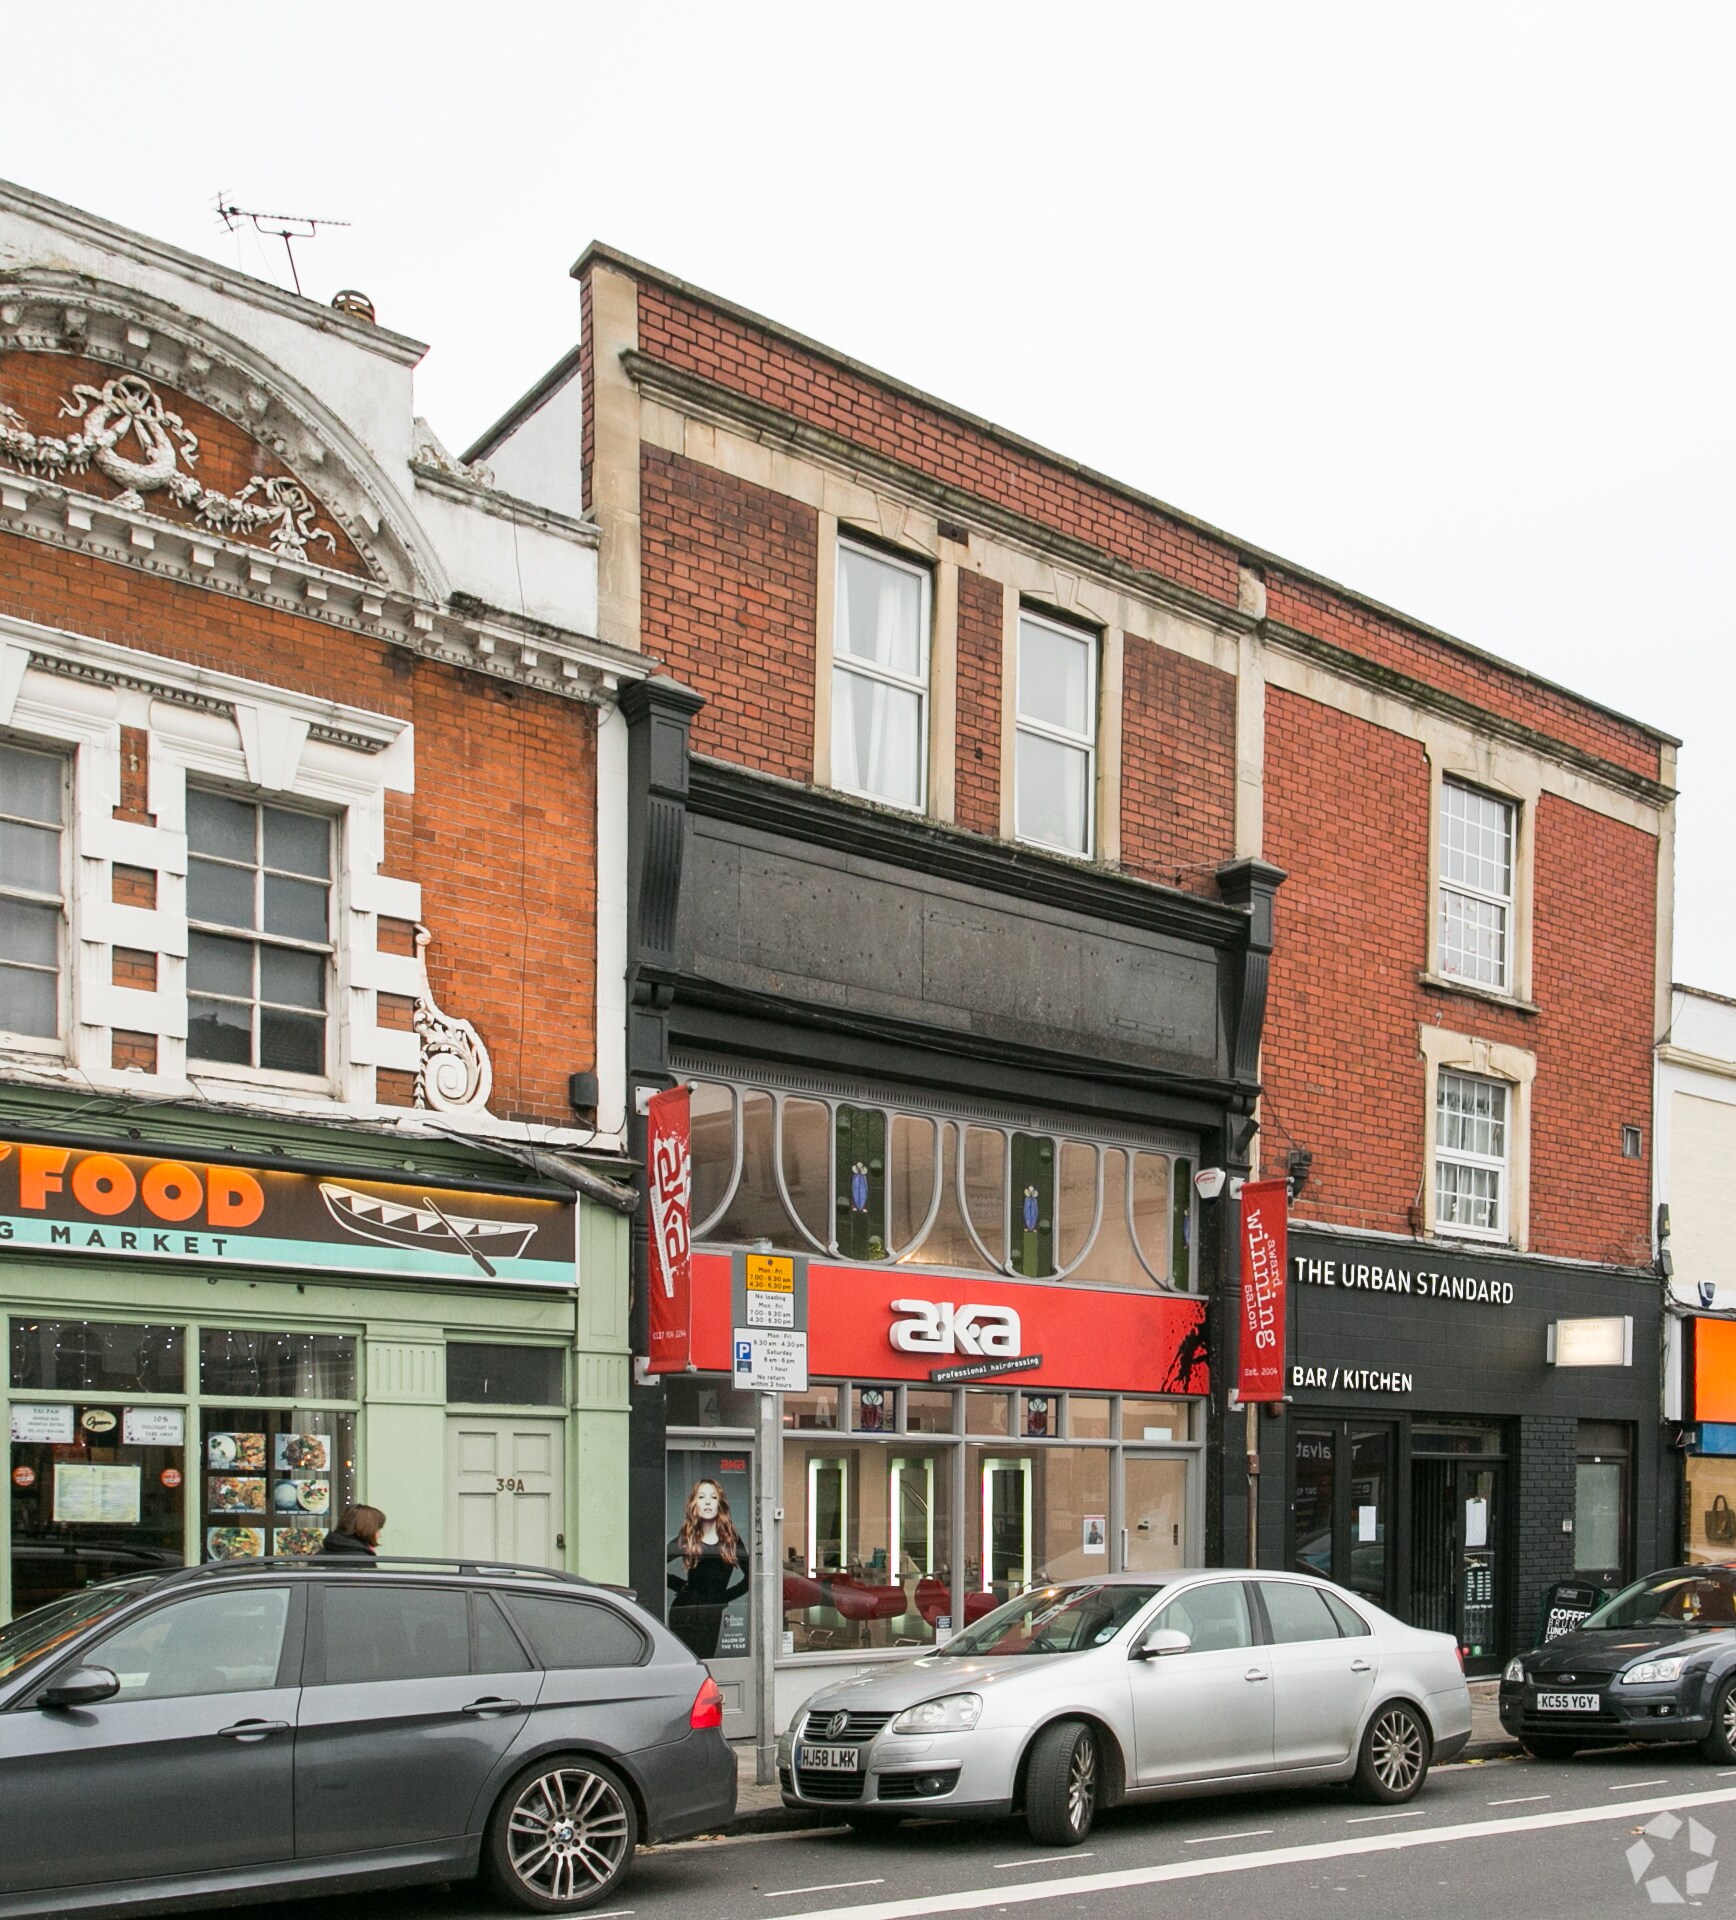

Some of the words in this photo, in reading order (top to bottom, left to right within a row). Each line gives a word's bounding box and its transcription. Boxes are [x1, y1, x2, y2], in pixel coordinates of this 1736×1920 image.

[20, 1146, 265, 1228] FOOD
[50, 1225, 228, 1256] MARKET
[1267, 1239, 1283, 1288] award
[1246, 1209, 1277, 1349] winning
[1295, 1257, 1336, 1286] THE
[1341, 1263, 1411, 1294] URBAN
[1416, 1271, 1514, 1305] STANDARD
[765, 1294, 786, 1302] loading
[1244, 1284, 1258, 1331] salon
[890, 1298, 1021, 1357] aka
[766, 1349, 792, 1357] Saturday
[937, 1365, 987, 1381] professional
[990, 1357, 1040, 1372] hairdressing
[1244, 1368, 1259, 1376] Est.
[1261, 1367, 1278, 1376] 2004
[1292, 1366, 1328, 1388] BAR
[1330, 1367, 1340, 1390] /
[1343, 1369, 1413, 1393] KITCHEN
[720, 1459, 746, 1471] aka
[496, 1478, 525, 1492] 39A
[1541, 1695, 1569, 1709] KC55
[1571, 1696, 1595, 1709] YGY
[802, 1749, 829, 1766] HJ58
[831, 1750, 855, 1768] LMK
